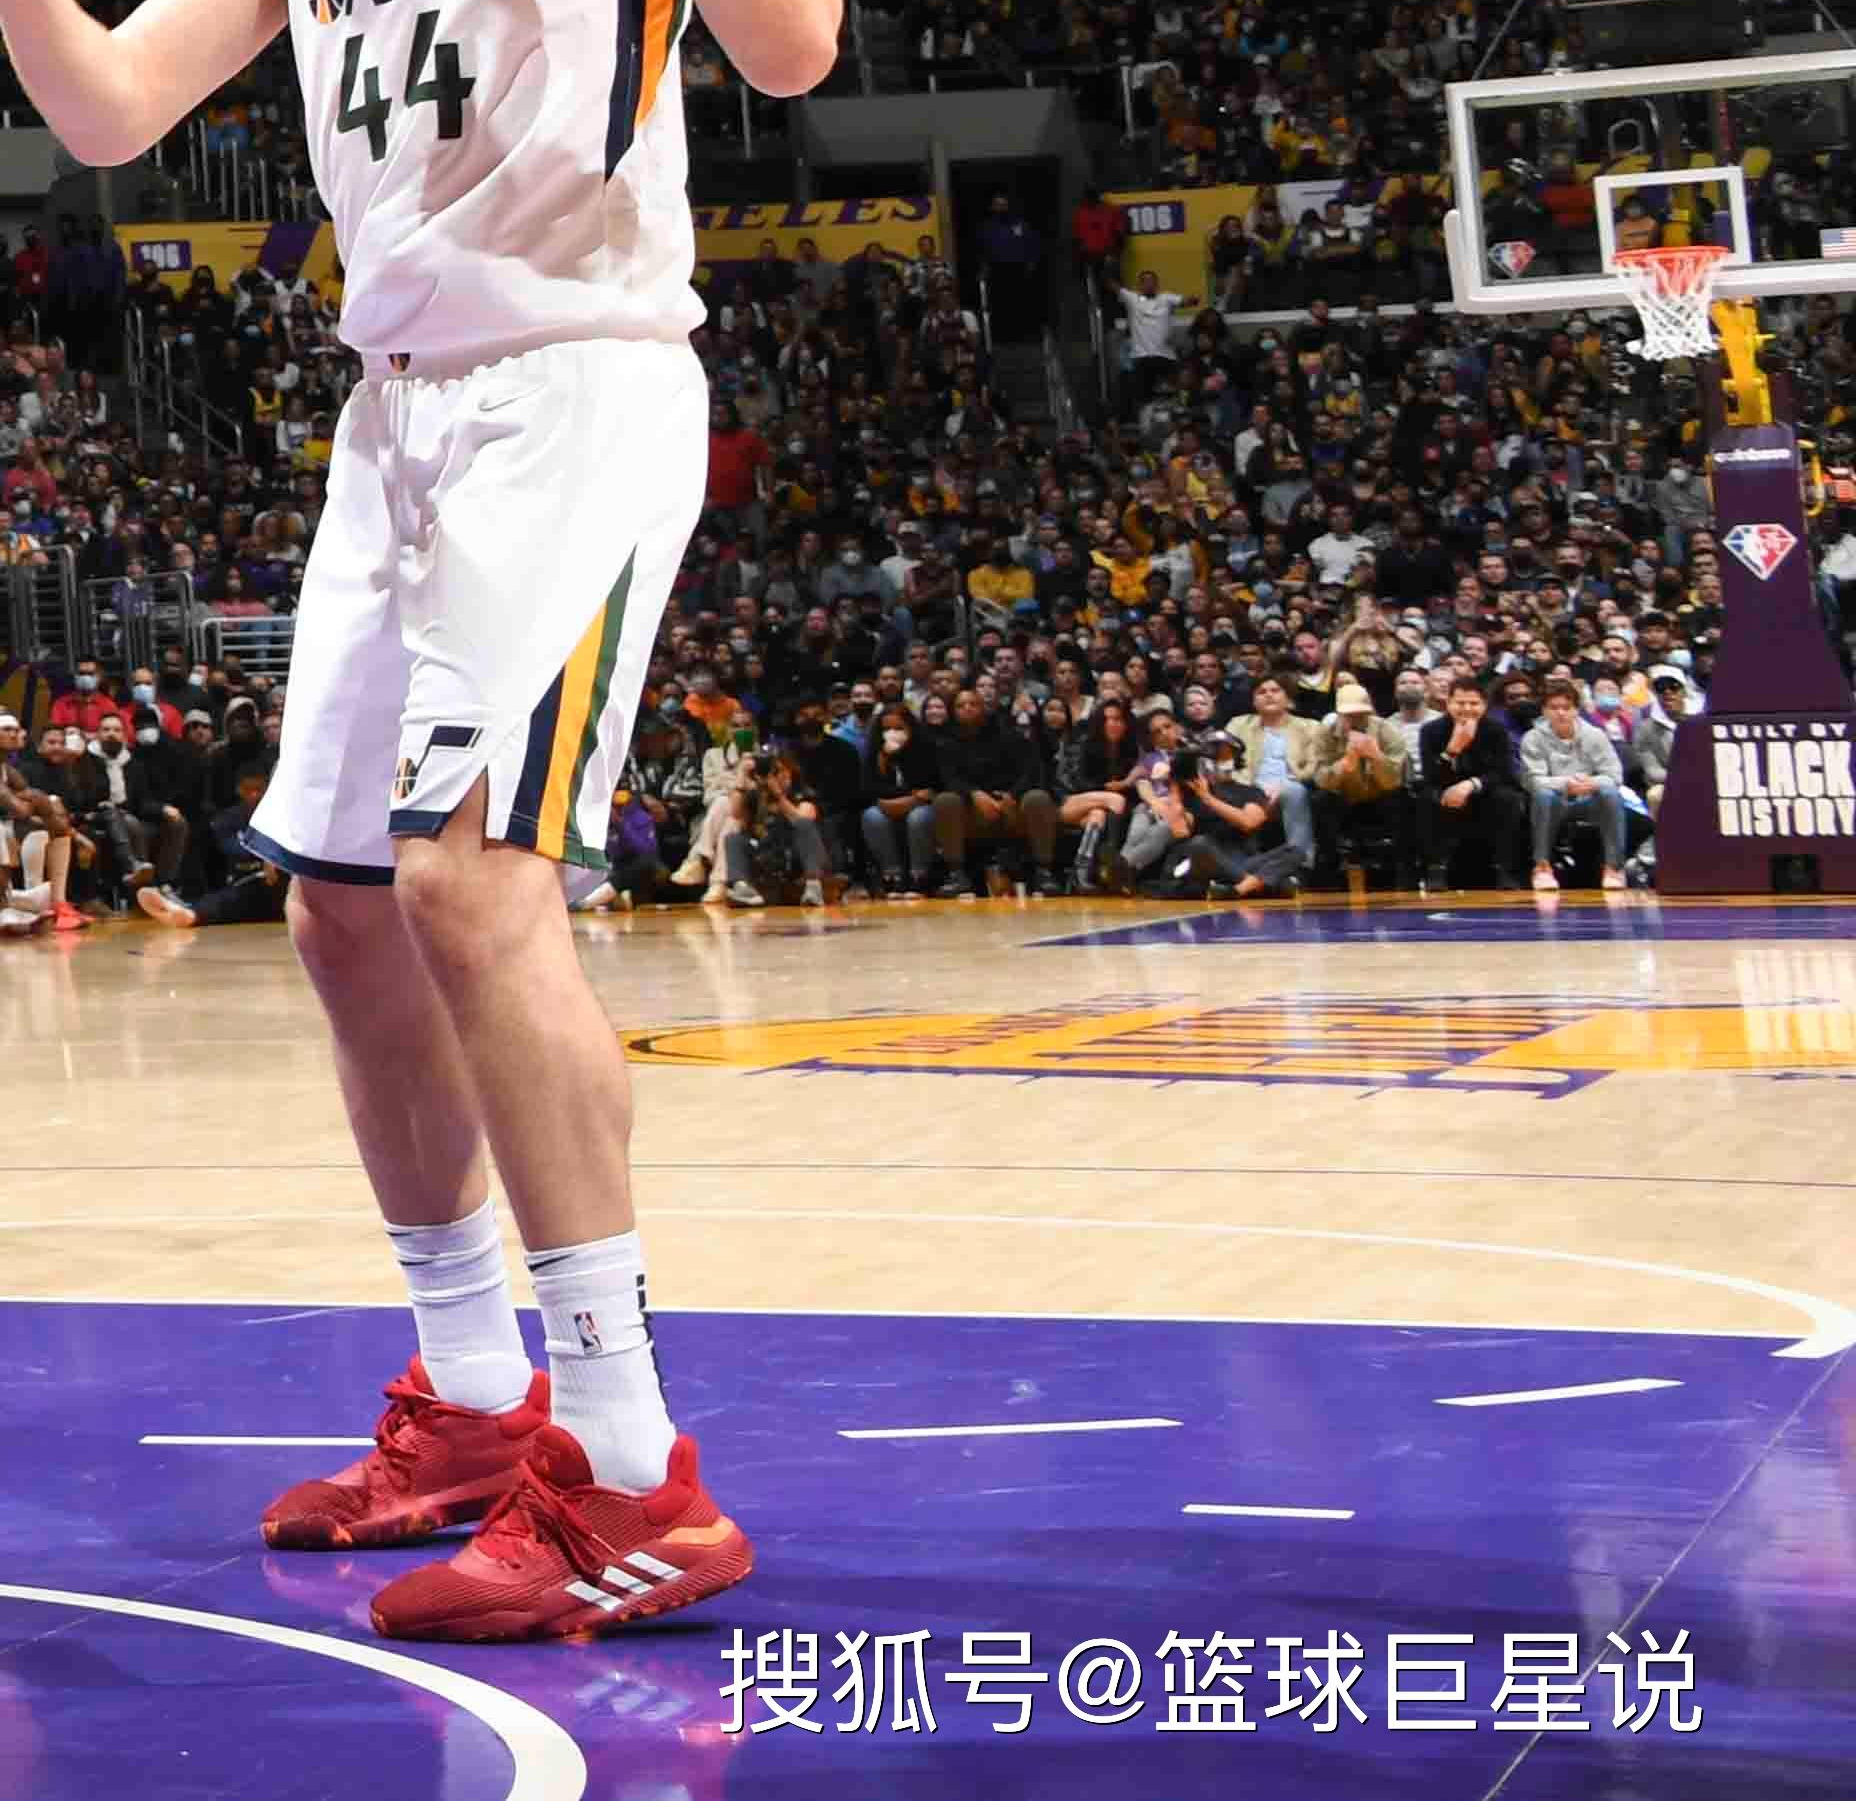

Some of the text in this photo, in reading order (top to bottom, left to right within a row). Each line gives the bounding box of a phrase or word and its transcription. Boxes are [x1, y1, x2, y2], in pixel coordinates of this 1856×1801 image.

[336, 9, 476, 163] 44
[1712, 723, 1798, 740] BUILT
[1713, 739, 1855, 799] BLACK
[1717, 797, 1856, 837] HISTORY
